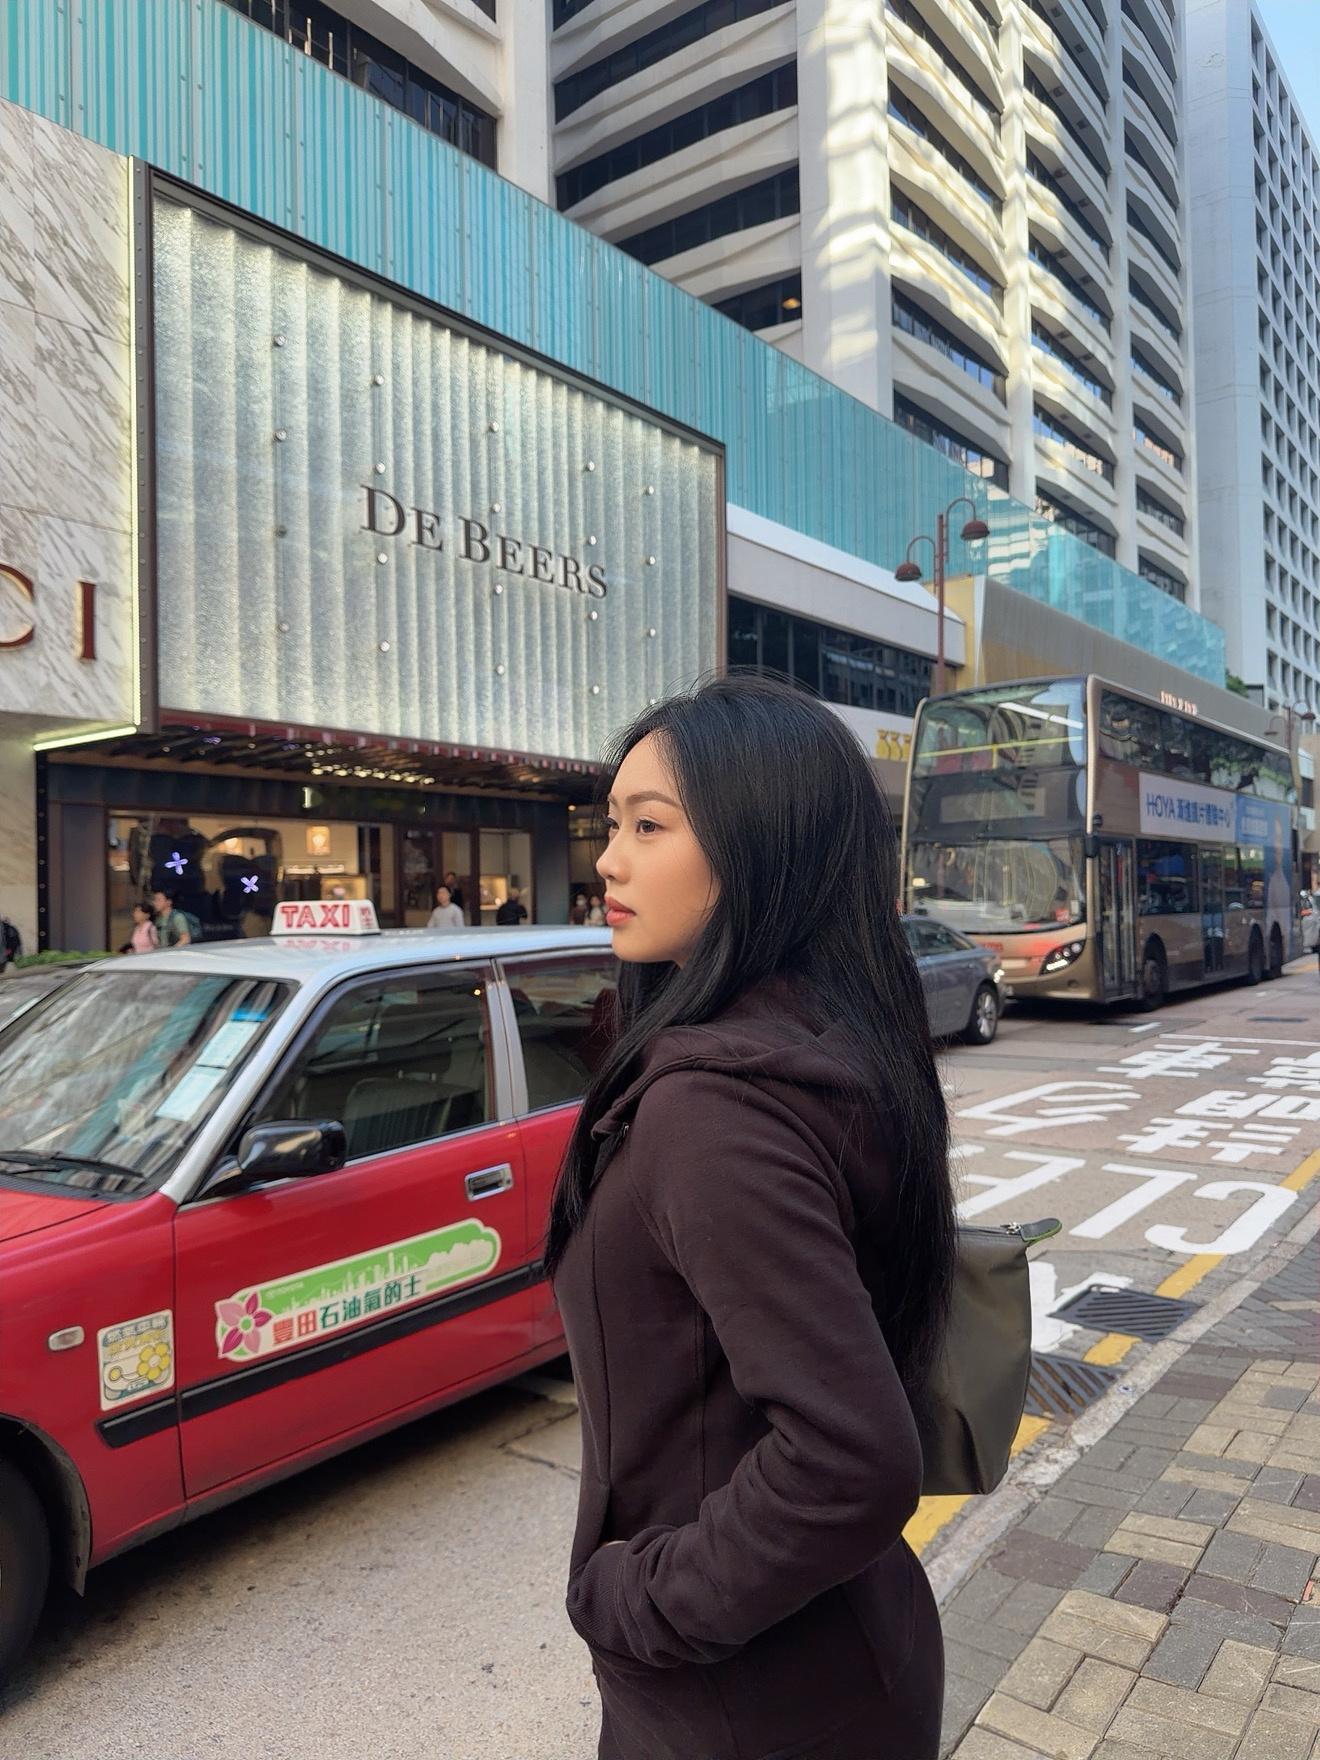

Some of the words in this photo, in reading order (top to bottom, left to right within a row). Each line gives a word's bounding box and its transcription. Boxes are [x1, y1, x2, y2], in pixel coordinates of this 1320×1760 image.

[360, 484, 443, 551] DE
[457, 515, 608, 600] BEERS
[1146, 793, 1176, 819] HOYA
[280, 904, 351, 929] TAXI
